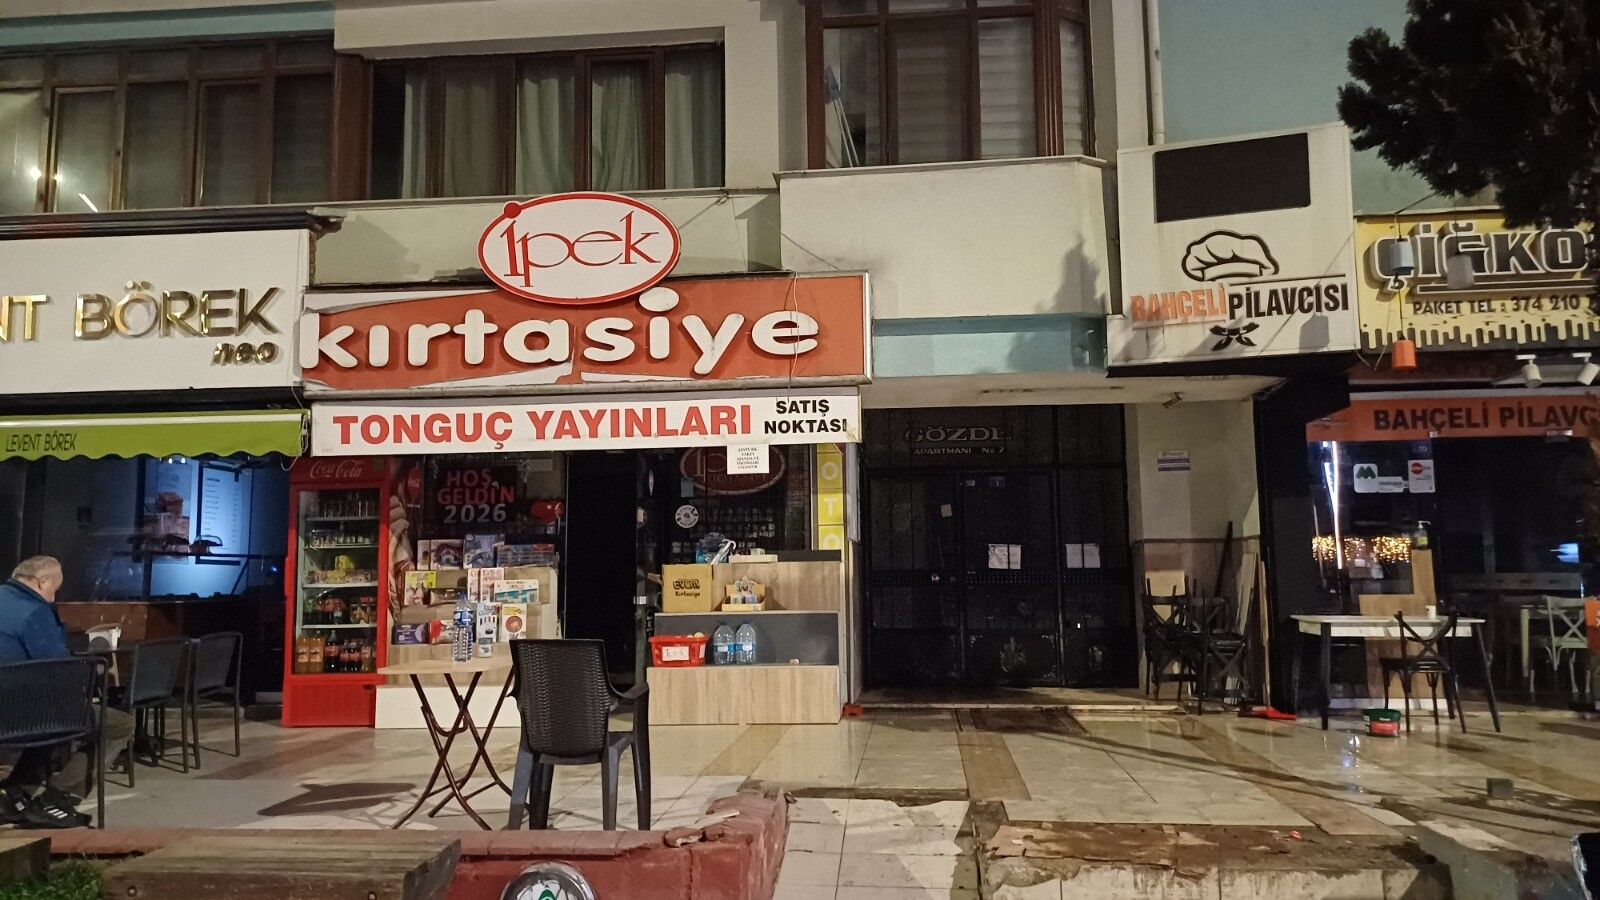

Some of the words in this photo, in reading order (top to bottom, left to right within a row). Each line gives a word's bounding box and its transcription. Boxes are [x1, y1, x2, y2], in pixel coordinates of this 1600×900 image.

[75, 280, 280, 340] BÖREK
[1130, 283, 1227, 322] BAHÇELİ
[1228, 282, 1349, 320] PİLAVCISI
[1412, 301, 1463, 315] PAKET
[1511, 296, 1544, 312] 374
[1549, 294, 1581, 311] 210
[299, 287, 819, 375] kırtasiye
[775, 399, 830, 416] SATIŞ
[1373, 402, 1489, 432] BAHÇELİ
[333, 411, 513, 449] TONGUÇ
[526, 405, 751, 440] YAYINLARI
[764, 418, 847, 434] NOKTASI
[5, 433, 42, 452] LEVENT
[44, 430, 78, 451] BÖREK
[446, 469, 492, 489] HOŞ
[443, 503, 507, 524] 2026
